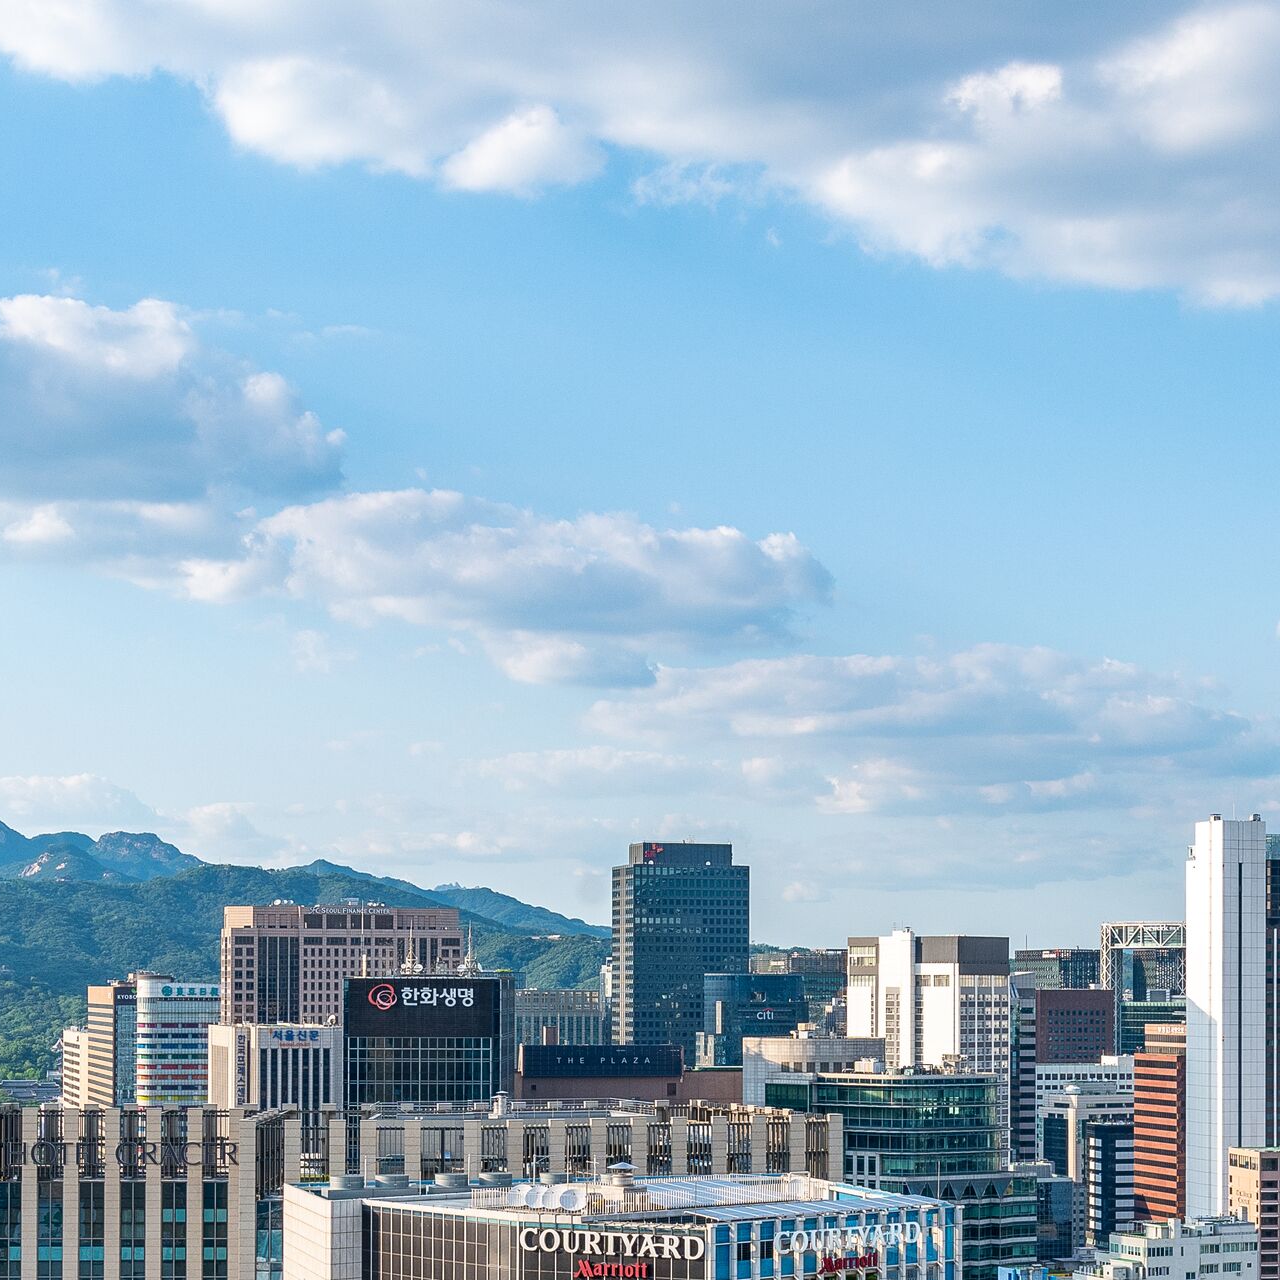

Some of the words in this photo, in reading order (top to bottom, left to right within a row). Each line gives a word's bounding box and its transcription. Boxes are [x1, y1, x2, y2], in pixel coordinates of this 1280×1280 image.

[401, 987, 474, 1007] 한화생명
[757, 1009, 773, 1020] citi
[272, 1030, 319, 1041] 서울신문
[7, 1141, 106, 1166] HOTEL
[520, 1227, 705, 1260] COURTYARD
[774, 1221, 921, 1254] COURTYARD
[573, 1259, 648, 1279] Marriott
[818, 1252, 878, 1274] Marriott
